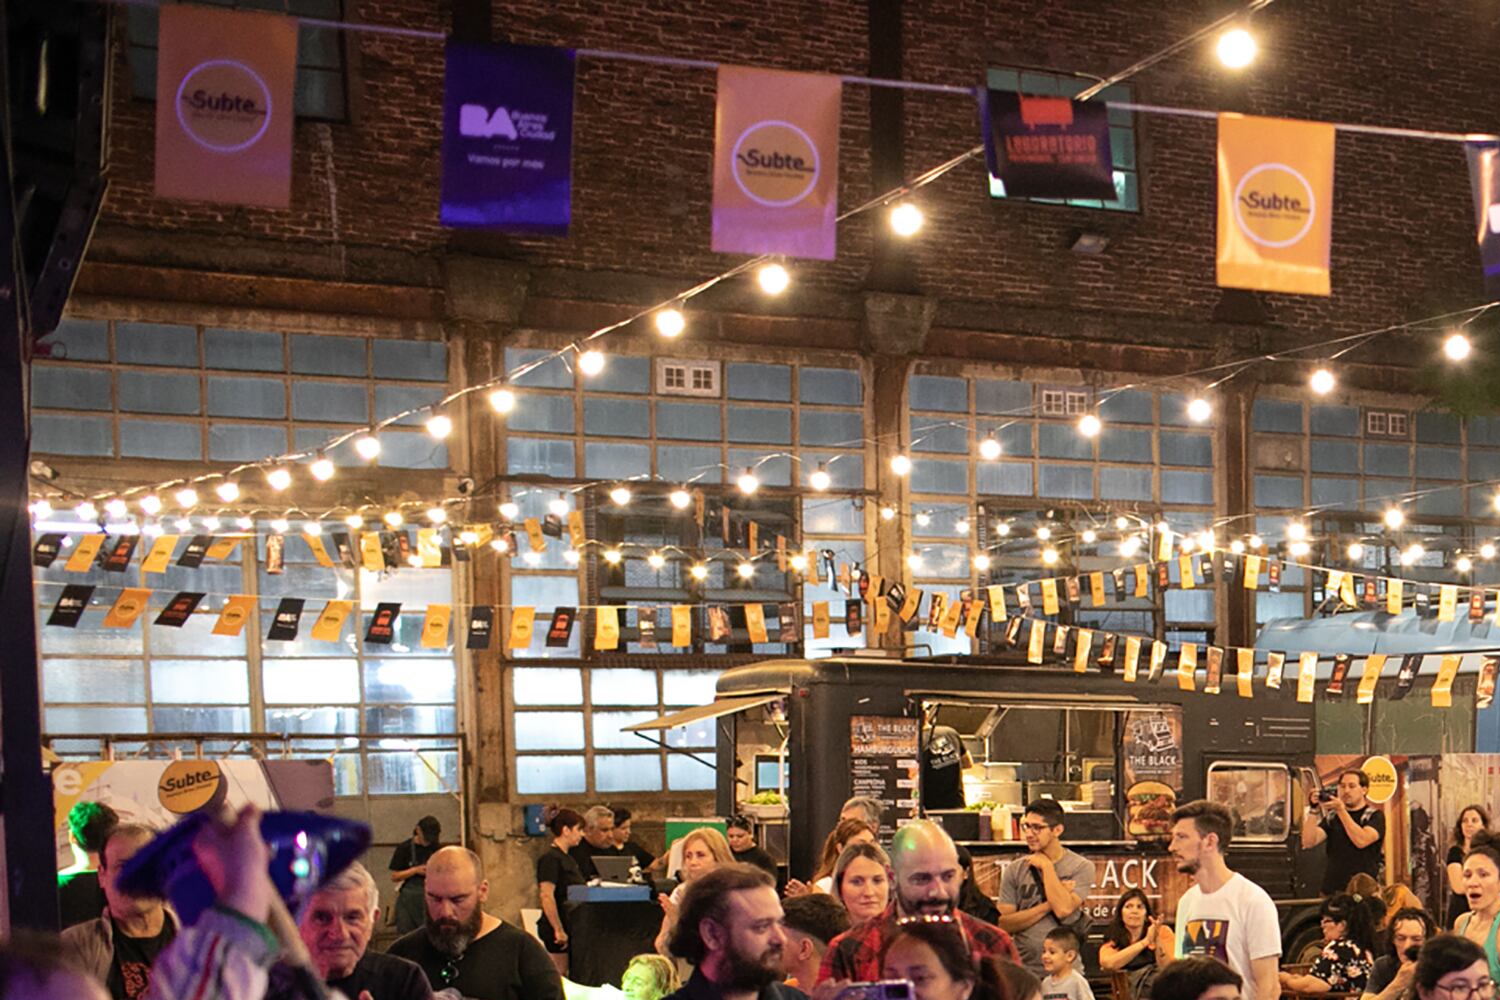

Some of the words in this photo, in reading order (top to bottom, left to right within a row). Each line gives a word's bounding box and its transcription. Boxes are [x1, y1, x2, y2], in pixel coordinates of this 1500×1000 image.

[185, 89, 263, 114] Subte
[459, 103, 518, 140] BA
[742, 148, 811, 171] Subte
[1244, 191, 1305, 212] Subte
[877, 724, 892, 732] THE
[893, 724, 916, 733] BLACK
[1129, 756, 1146, 766] THE
[1148, 756, 1176, 766] BLACK
[163, 769, 216, 792] Subte
[1090, 860, 1158, 889] ACK
[1093, 904, 1108, 918] de
